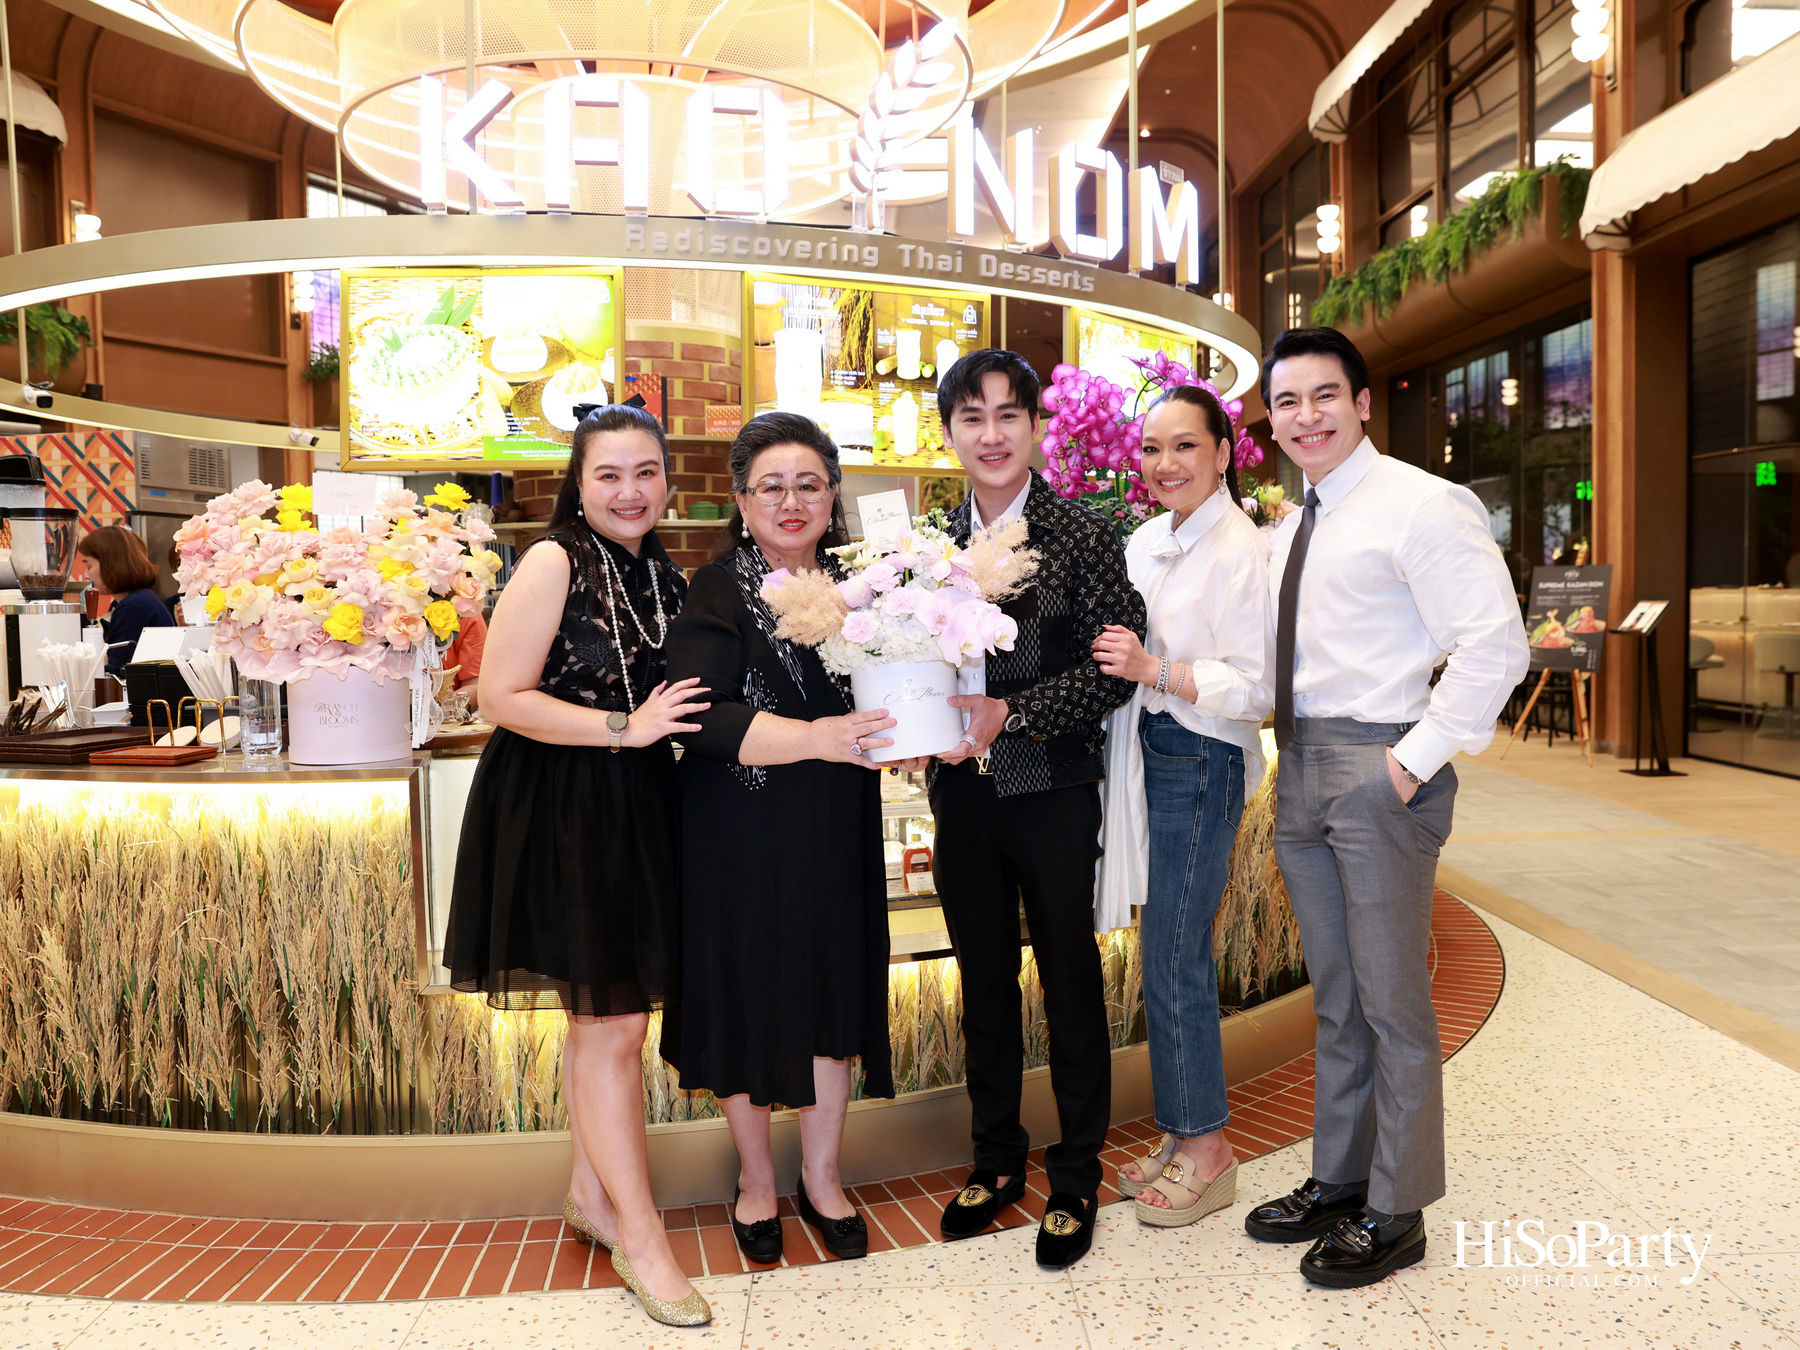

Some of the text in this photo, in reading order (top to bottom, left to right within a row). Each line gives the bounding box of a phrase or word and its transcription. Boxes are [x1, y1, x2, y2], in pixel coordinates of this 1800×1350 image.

[947, 101, 1199, 285] NOM
[625, 224, 1094, 292] Rediscovering Thai Desserts
[314, 703, 359, 715] BRANCH
[319, 715, 359, 725] BLOOMS
